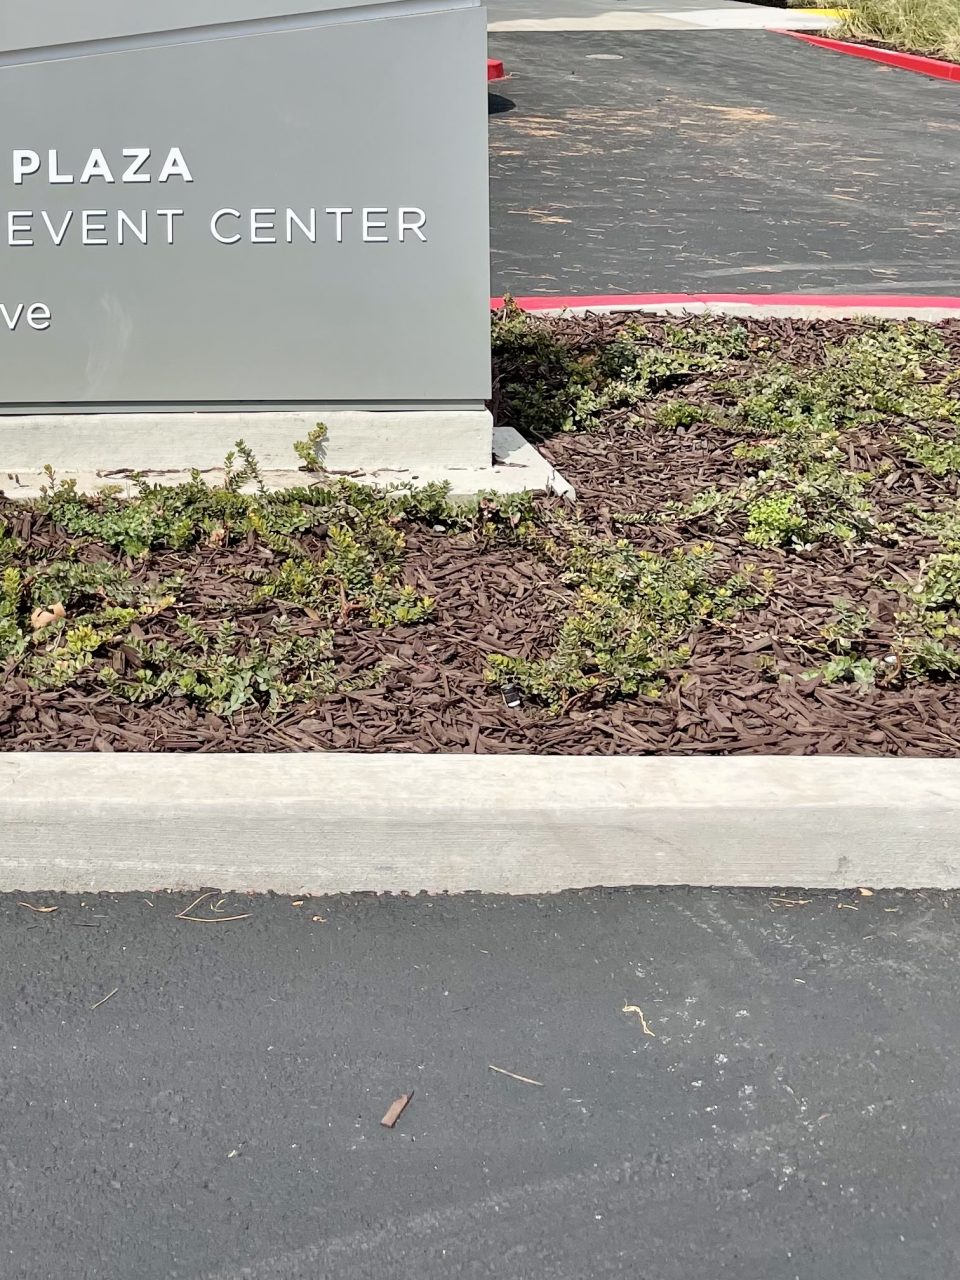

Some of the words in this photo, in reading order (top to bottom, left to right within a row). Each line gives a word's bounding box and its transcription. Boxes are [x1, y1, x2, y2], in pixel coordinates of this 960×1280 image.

[12, 147, 195, 186] PLAZA
[7, 209, 185, 247] EVENT
[210, 206, 428, 246] CENTER
